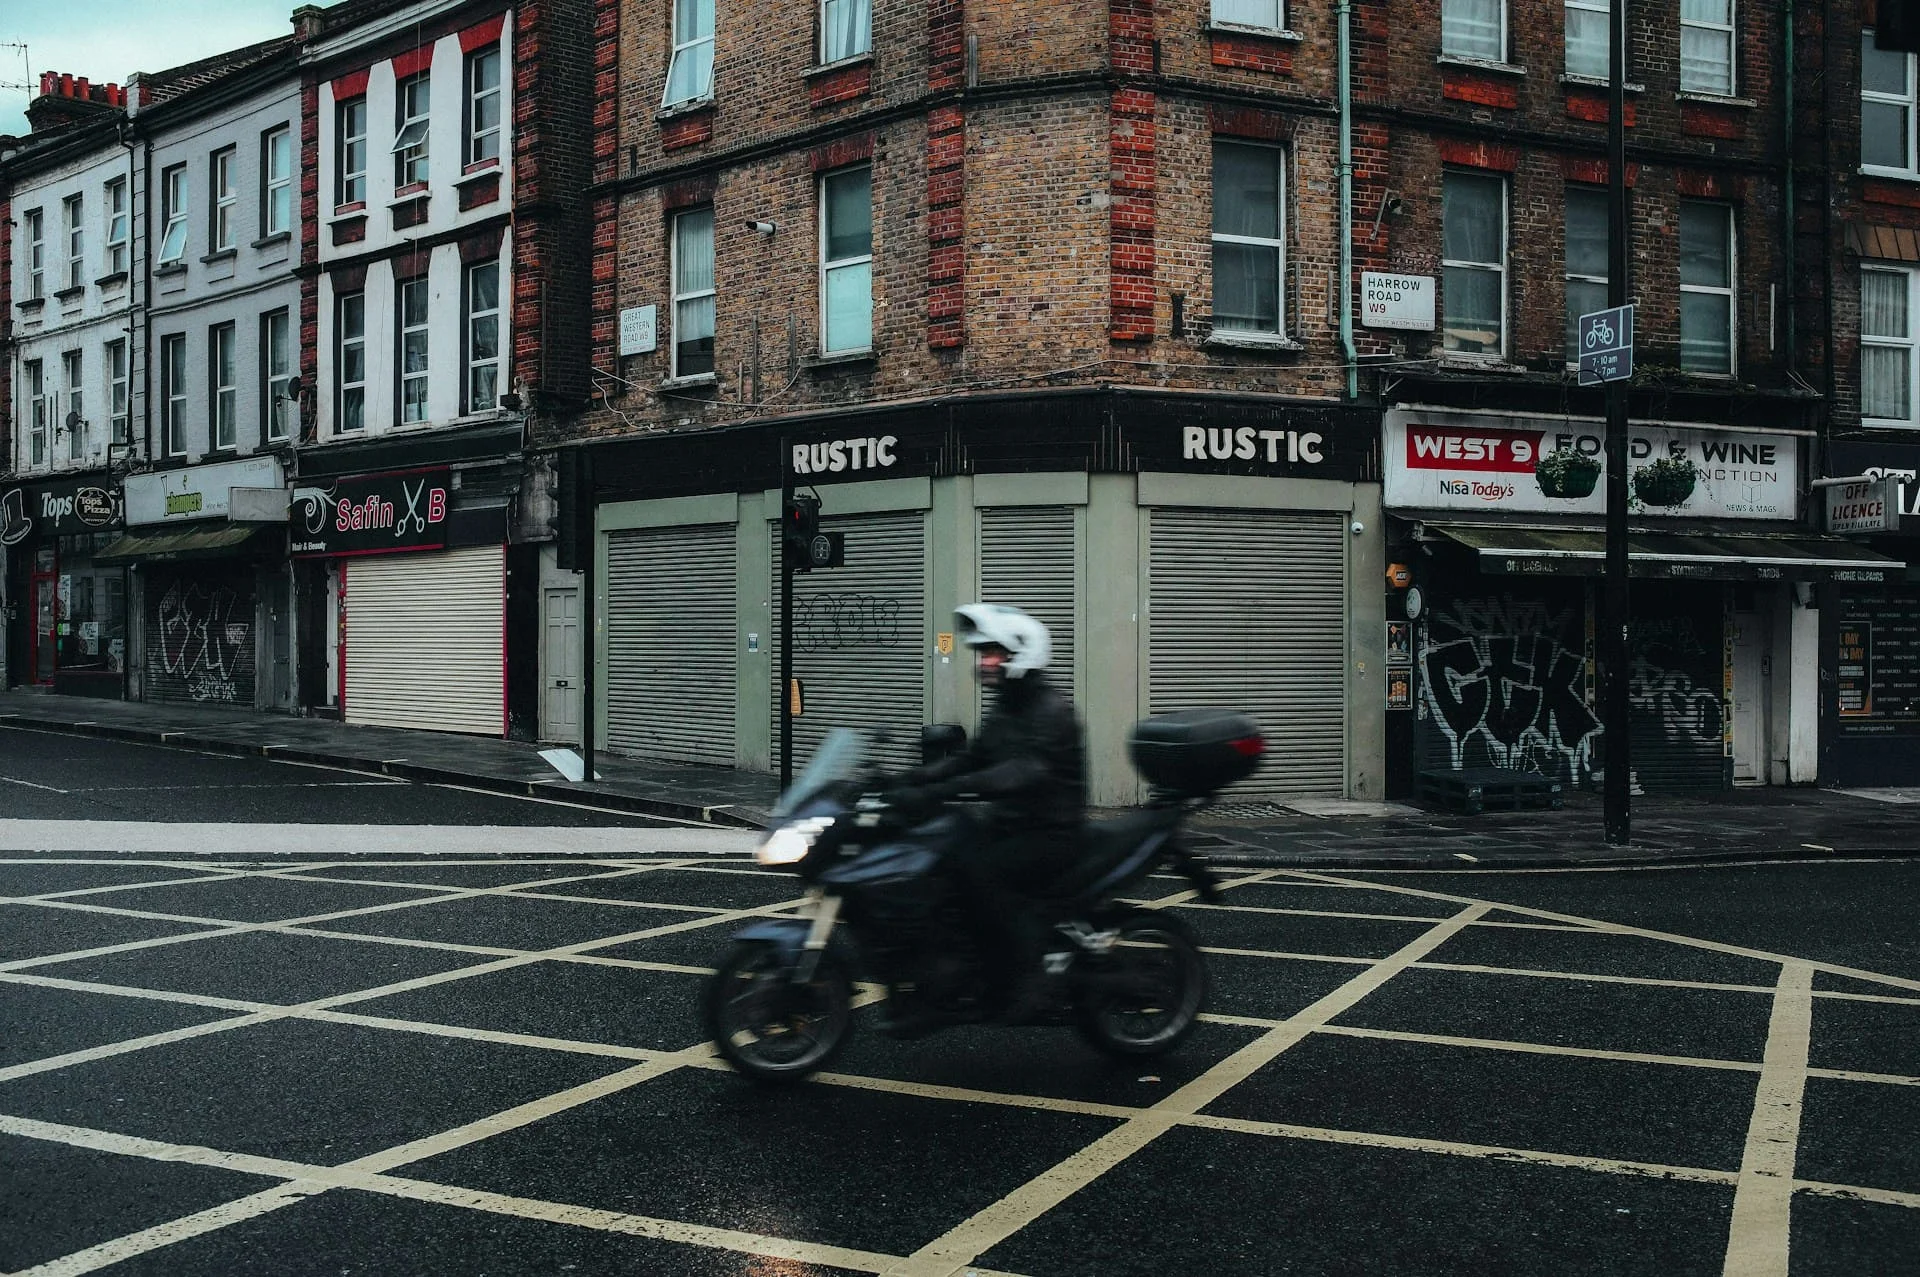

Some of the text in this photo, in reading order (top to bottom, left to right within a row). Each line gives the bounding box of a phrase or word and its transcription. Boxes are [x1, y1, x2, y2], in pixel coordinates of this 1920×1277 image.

[1368, 277, 1421, 291] HARROW
[1368, 290, 1402, 302] ROAD
[1369, 302, 1386, 314] W9
[623, 311, 641, 323] GREAT
[623, 320, 650, 334] WESTERN
[623, 333, 639, 344] ROAD
[1183, 426, 1324, 464] RUSTIC
[1414, 434, 1502, 462] WEST
[1511, 440, 1532, 463] 9
[1555, 433, 1652, 460] FOD
[1700, 441, 1777, 466] WINE
[792, 435, 899, 474] RUSTIC
[1699, 467, 1777, 483] NCTION
[1440, 480, 1514, 500] Nisa Today's
[1845, 484, 1869, 500] OFF
[80, 496, 103, 507] Tops
[1726, 503, 1777, 513] NEWS & MAGS
[41, 491, 73, 528] Tops
[83, 504, 111, 514] Pizza
[336, 487, 446, 532] Safin B
[1832, 501, 1883, 521] LICENCE
[1865, 519, 1881, 528] LATE
[292, 542, 303, 551] Hair
[308, 541, 327, 551] Beauty
